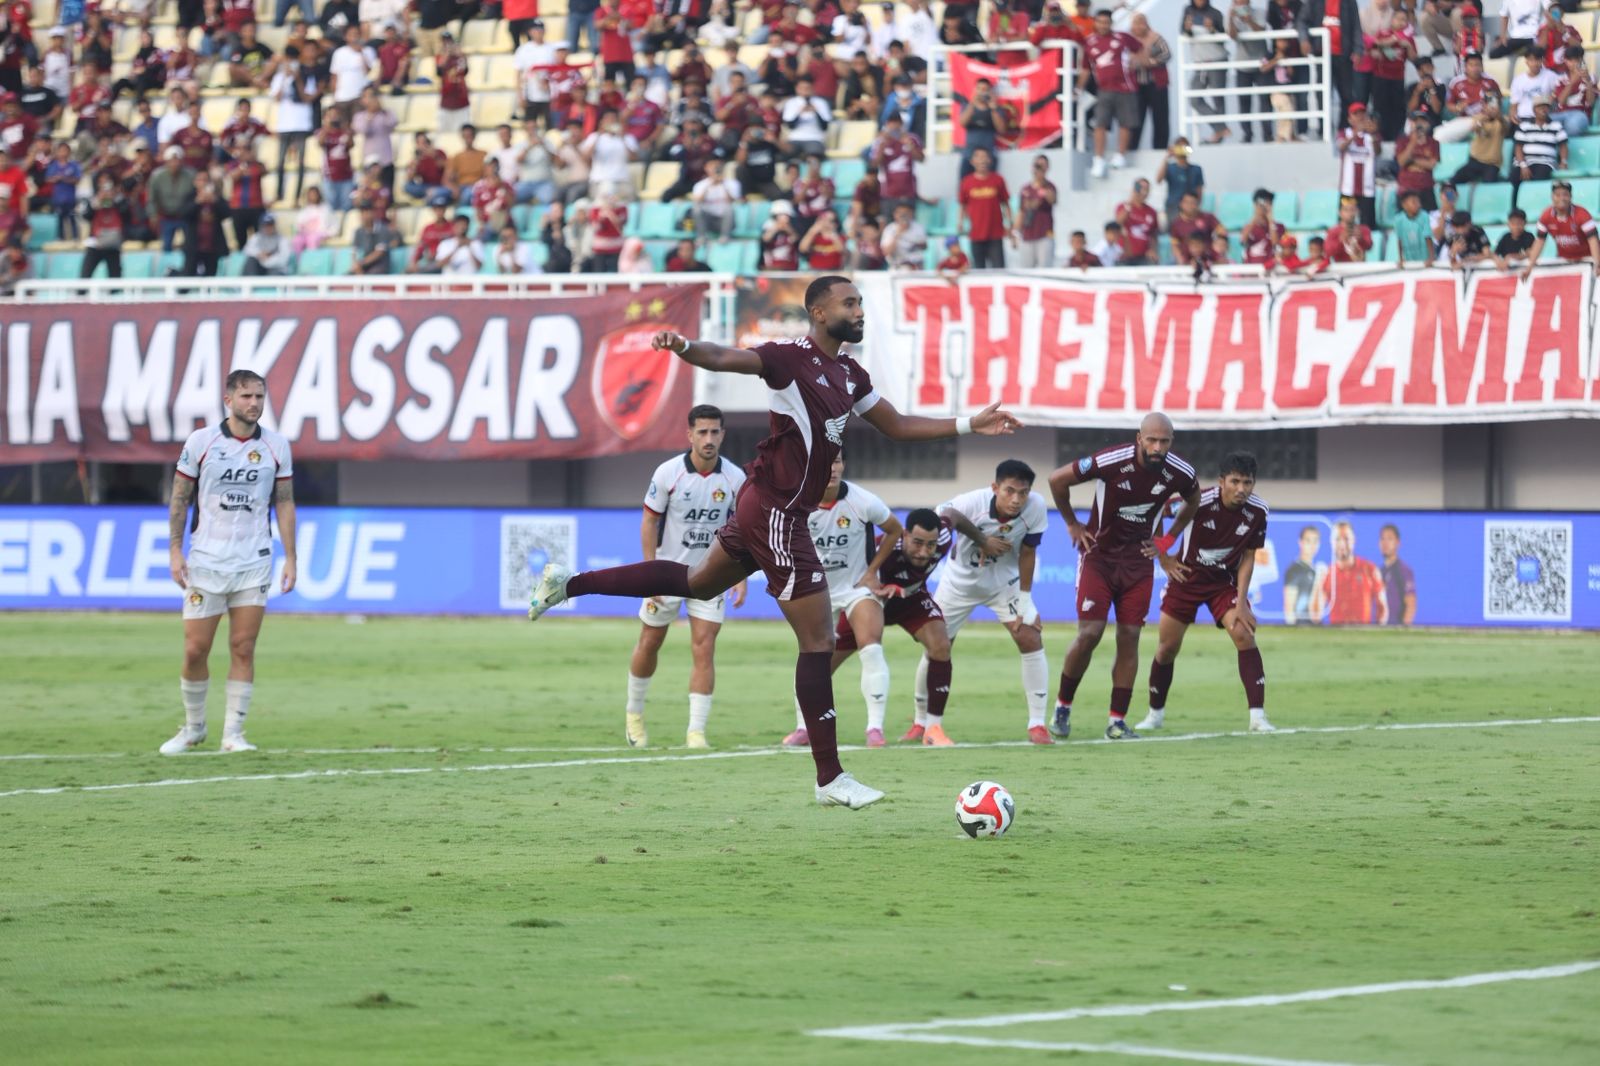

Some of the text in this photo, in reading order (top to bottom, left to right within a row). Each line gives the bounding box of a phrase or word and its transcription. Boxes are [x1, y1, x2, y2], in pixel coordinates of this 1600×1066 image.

[904, 274, 1600, 411] THEMACZMA
[0, 315, 582, 444] IA MAKASSAR
[220, 468, 259, 482] AFG
[684, 508, 721, 521] AFG
[85, 520, 406, 599] LEUE
[815, 534, 849, 547] AFG
